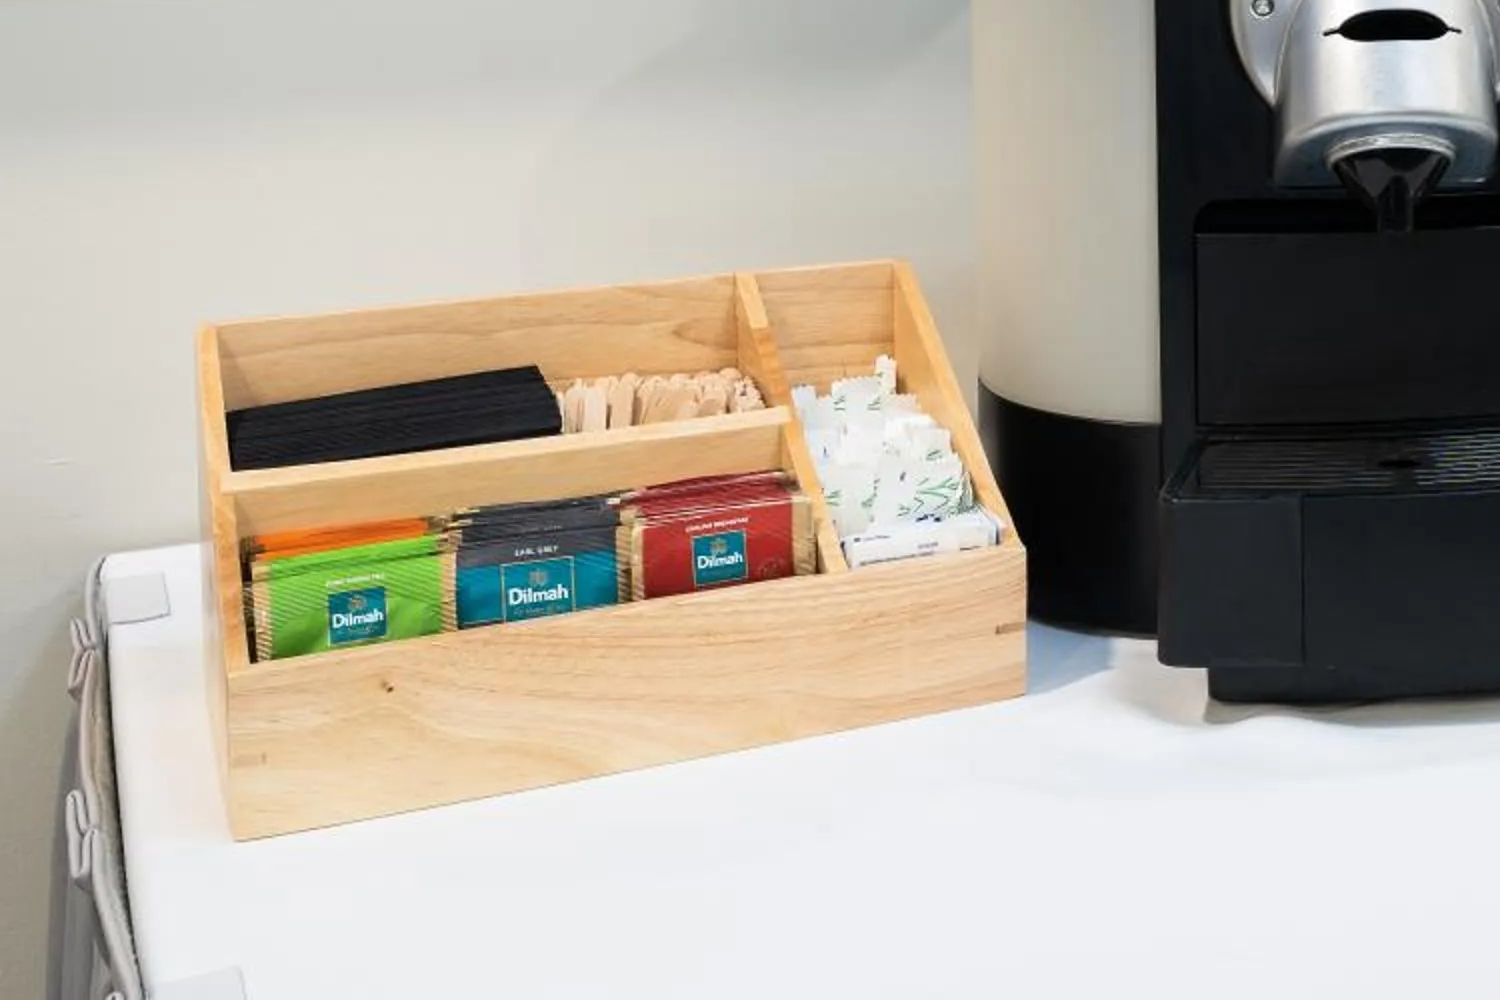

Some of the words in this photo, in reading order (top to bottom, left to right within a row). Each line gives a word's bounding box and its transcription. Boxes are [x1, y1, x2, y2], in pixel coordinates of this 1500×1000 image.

[696, 551, 744, 570] Dilmah
[507, 583, 569, 606] Dilmah
[331, 607, 385, 629] Dilmah
